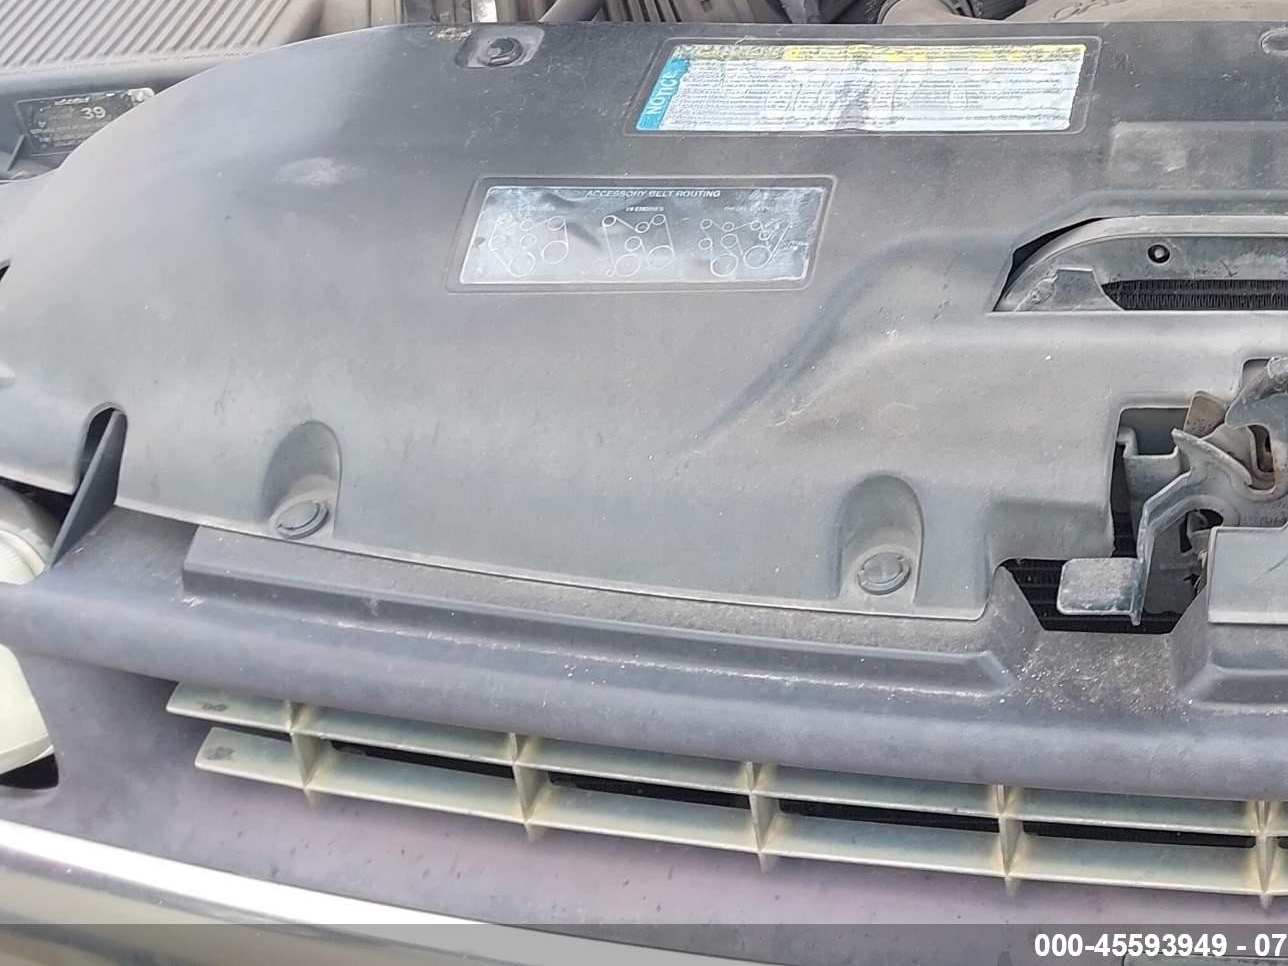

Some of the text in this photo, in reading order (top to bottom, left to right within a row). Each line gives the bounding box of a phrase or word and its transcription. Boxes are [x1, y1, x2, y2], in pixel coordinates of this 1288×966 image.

[80, 106, 106, 119] 39
[584, 189, 722, 199] ACCESSORY BELT ROUTING
